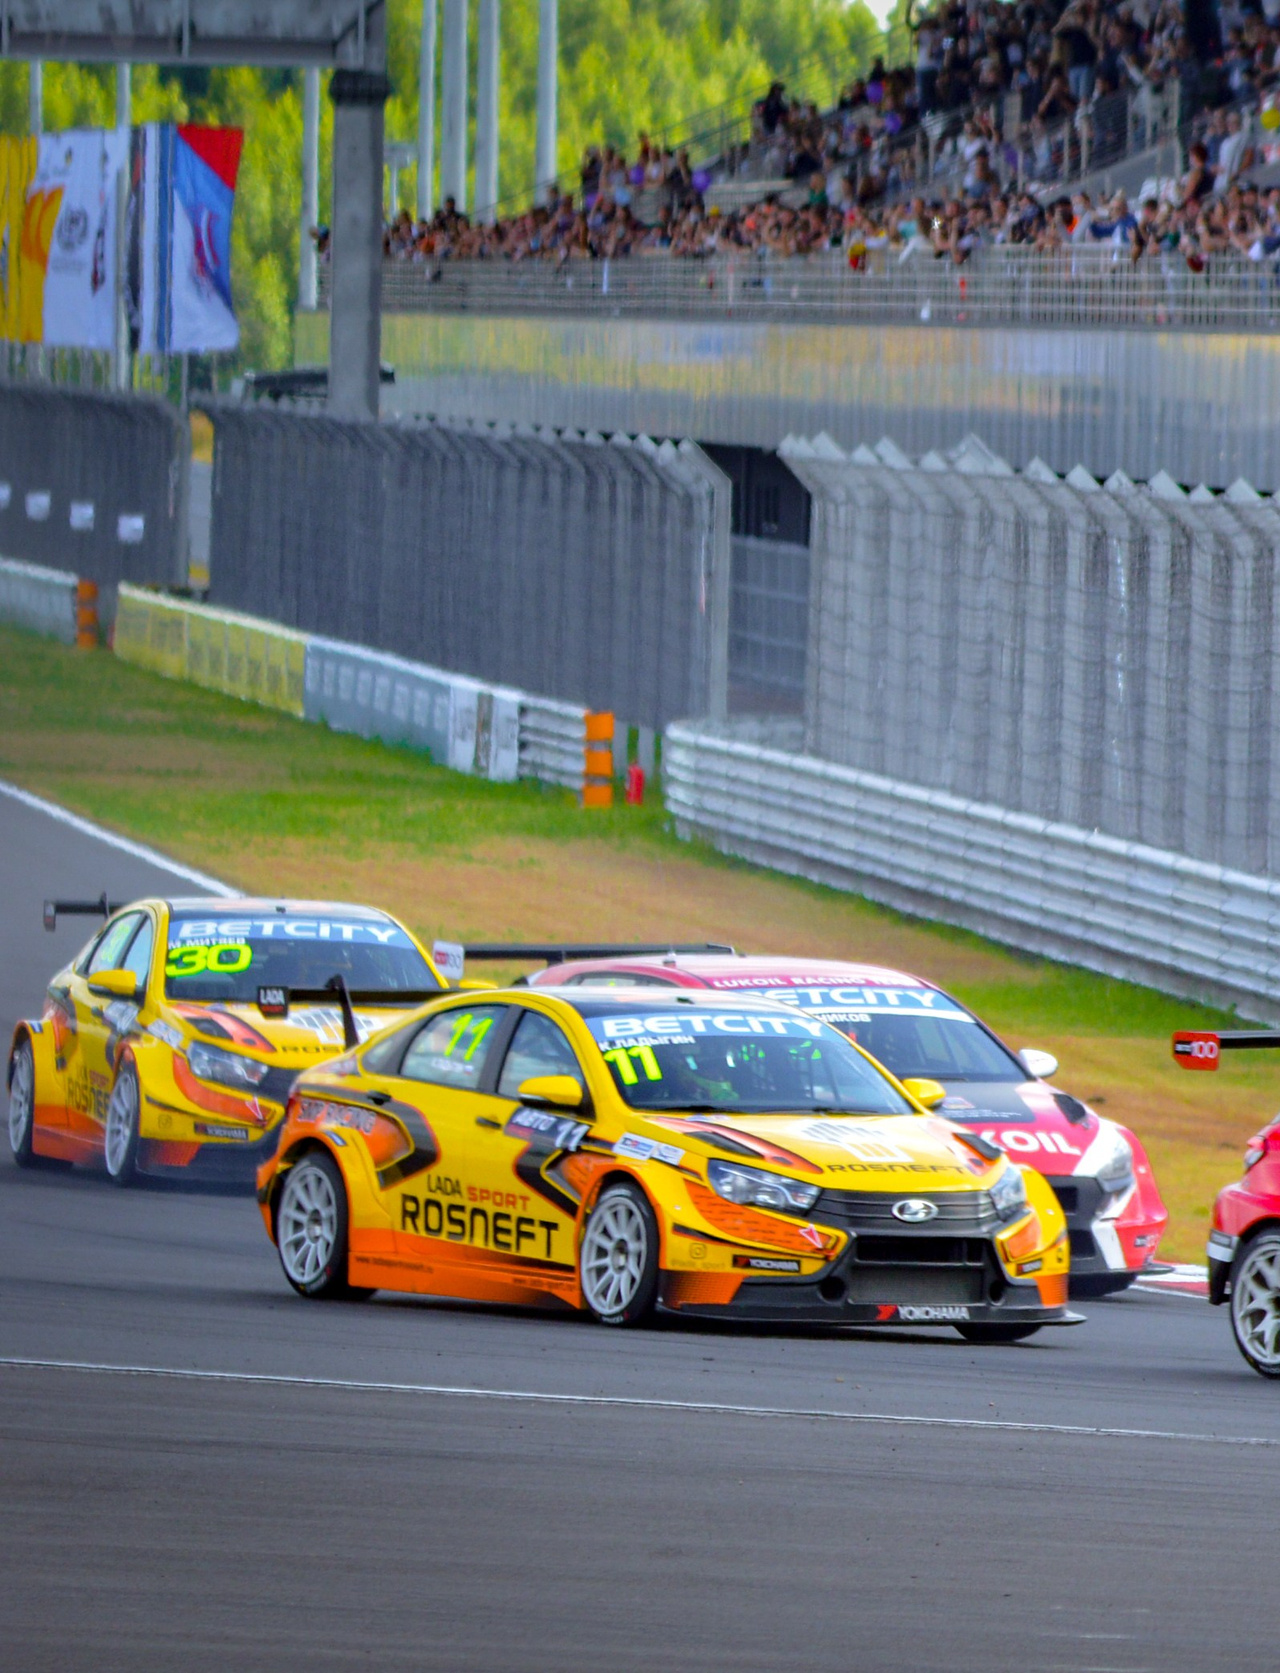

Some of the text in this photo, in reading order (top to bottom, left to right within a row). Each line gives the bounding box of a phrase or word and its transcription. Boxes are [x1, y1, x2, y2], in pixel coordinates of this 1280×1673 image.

[179, 921, 398, 942] BETCITY
[165, 944, 253, 978] 30
[714, 977, 788, 988] LUKOIL
[260, 988, 285, 1005] LADA
[444, 1013, 493, 1062] 11
[602, 1015, 823, 1037] BETCITY
[604, 1045, 663, 1086] 11
[555, 1120, 590, 1152] 11
[827, 1163, 965, 1175] ROSNEFT
[427, 1174, 531, 1212] LADA SPORT
[401, 1193, 559, 1258] ROSNEFT
[897, 1304, 970, 1321] YOKOHAMA
